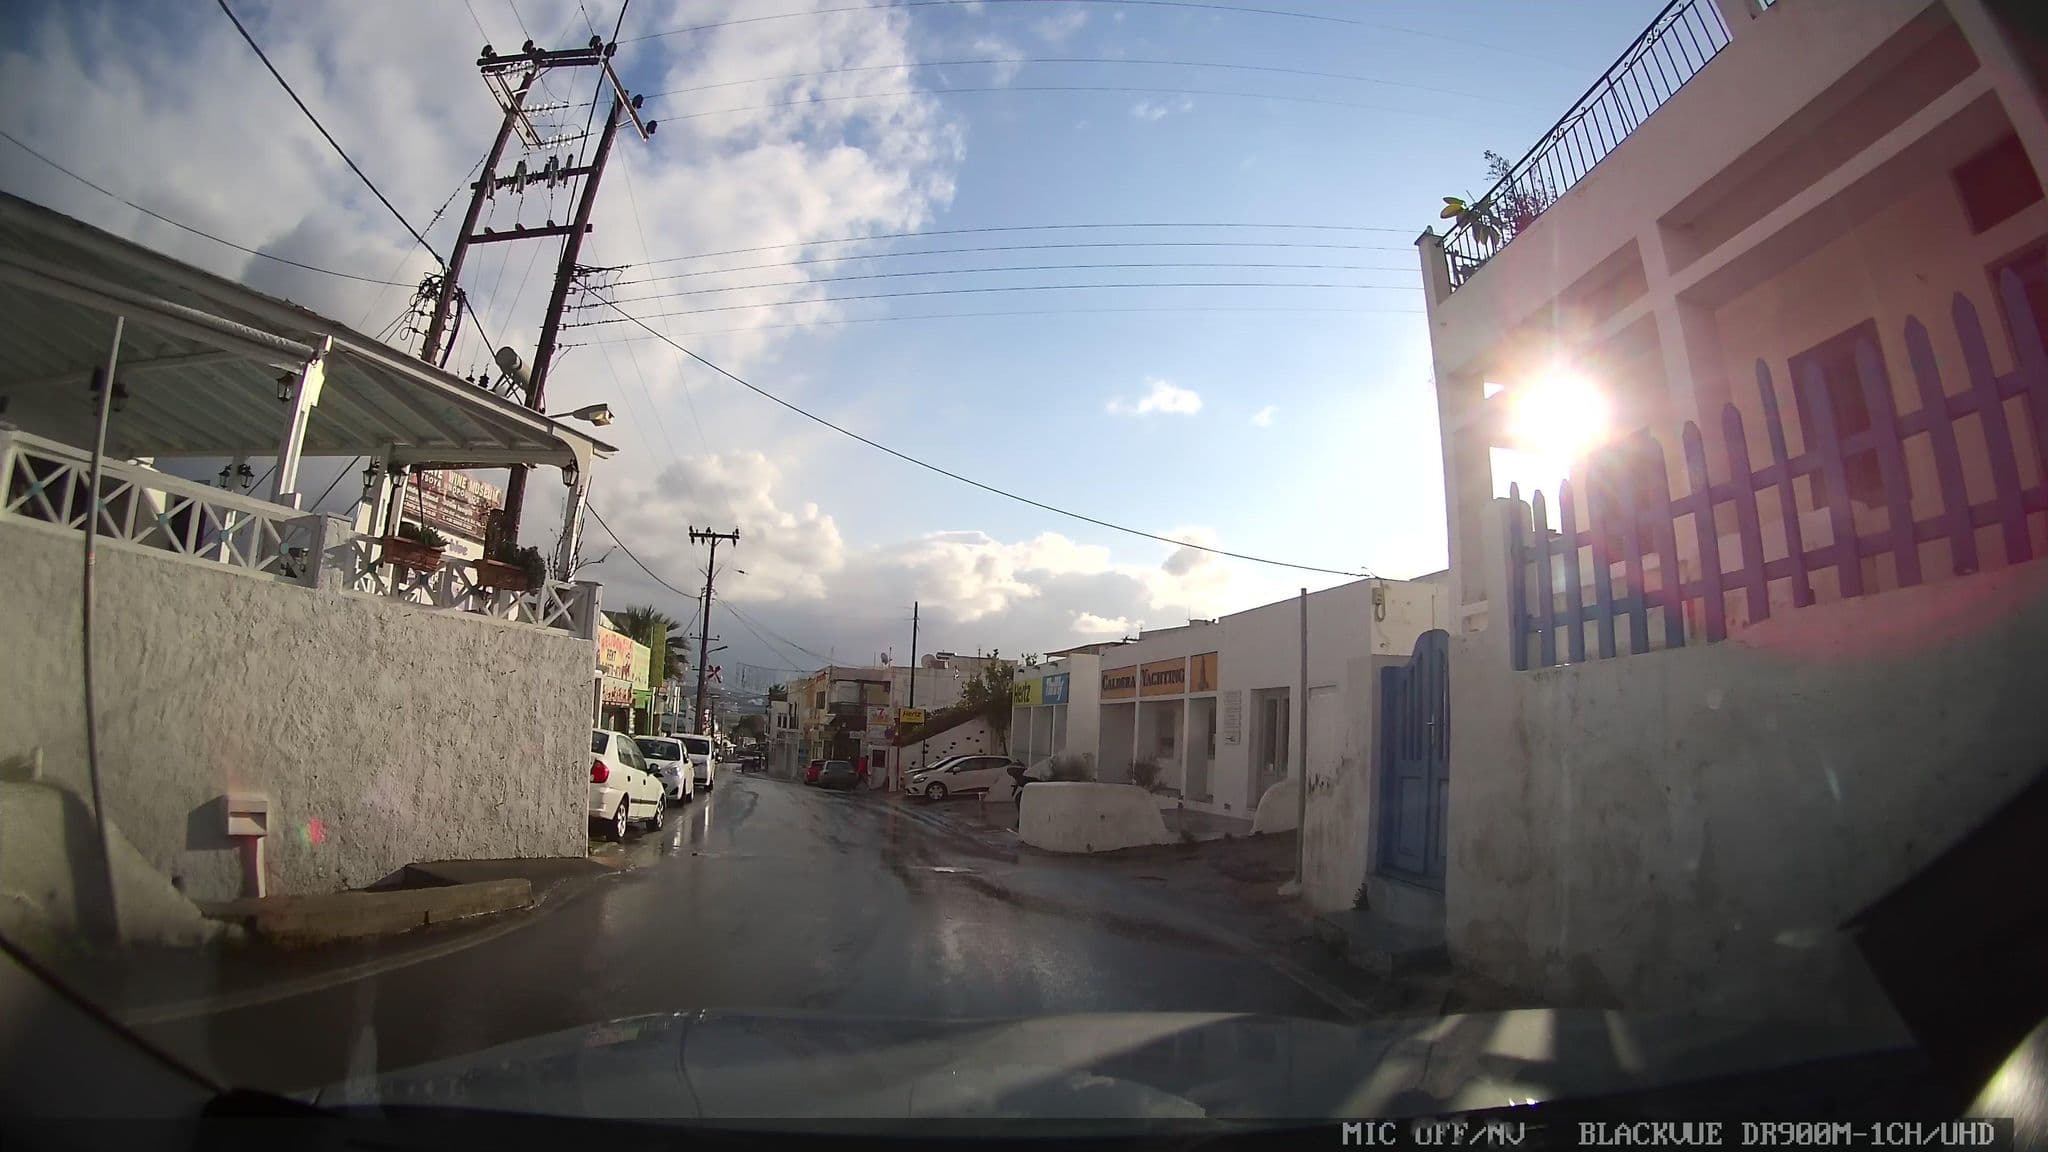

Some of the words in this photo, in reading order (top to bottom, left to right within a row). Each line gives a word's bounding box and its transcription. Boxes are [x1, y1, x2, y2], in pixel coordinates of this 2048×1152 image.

[1102, 674, 1136, 690] CALDERA
[1141, 668, 1186, 687] YACHTING
[1014, 679, 1031, 703] Hertz
